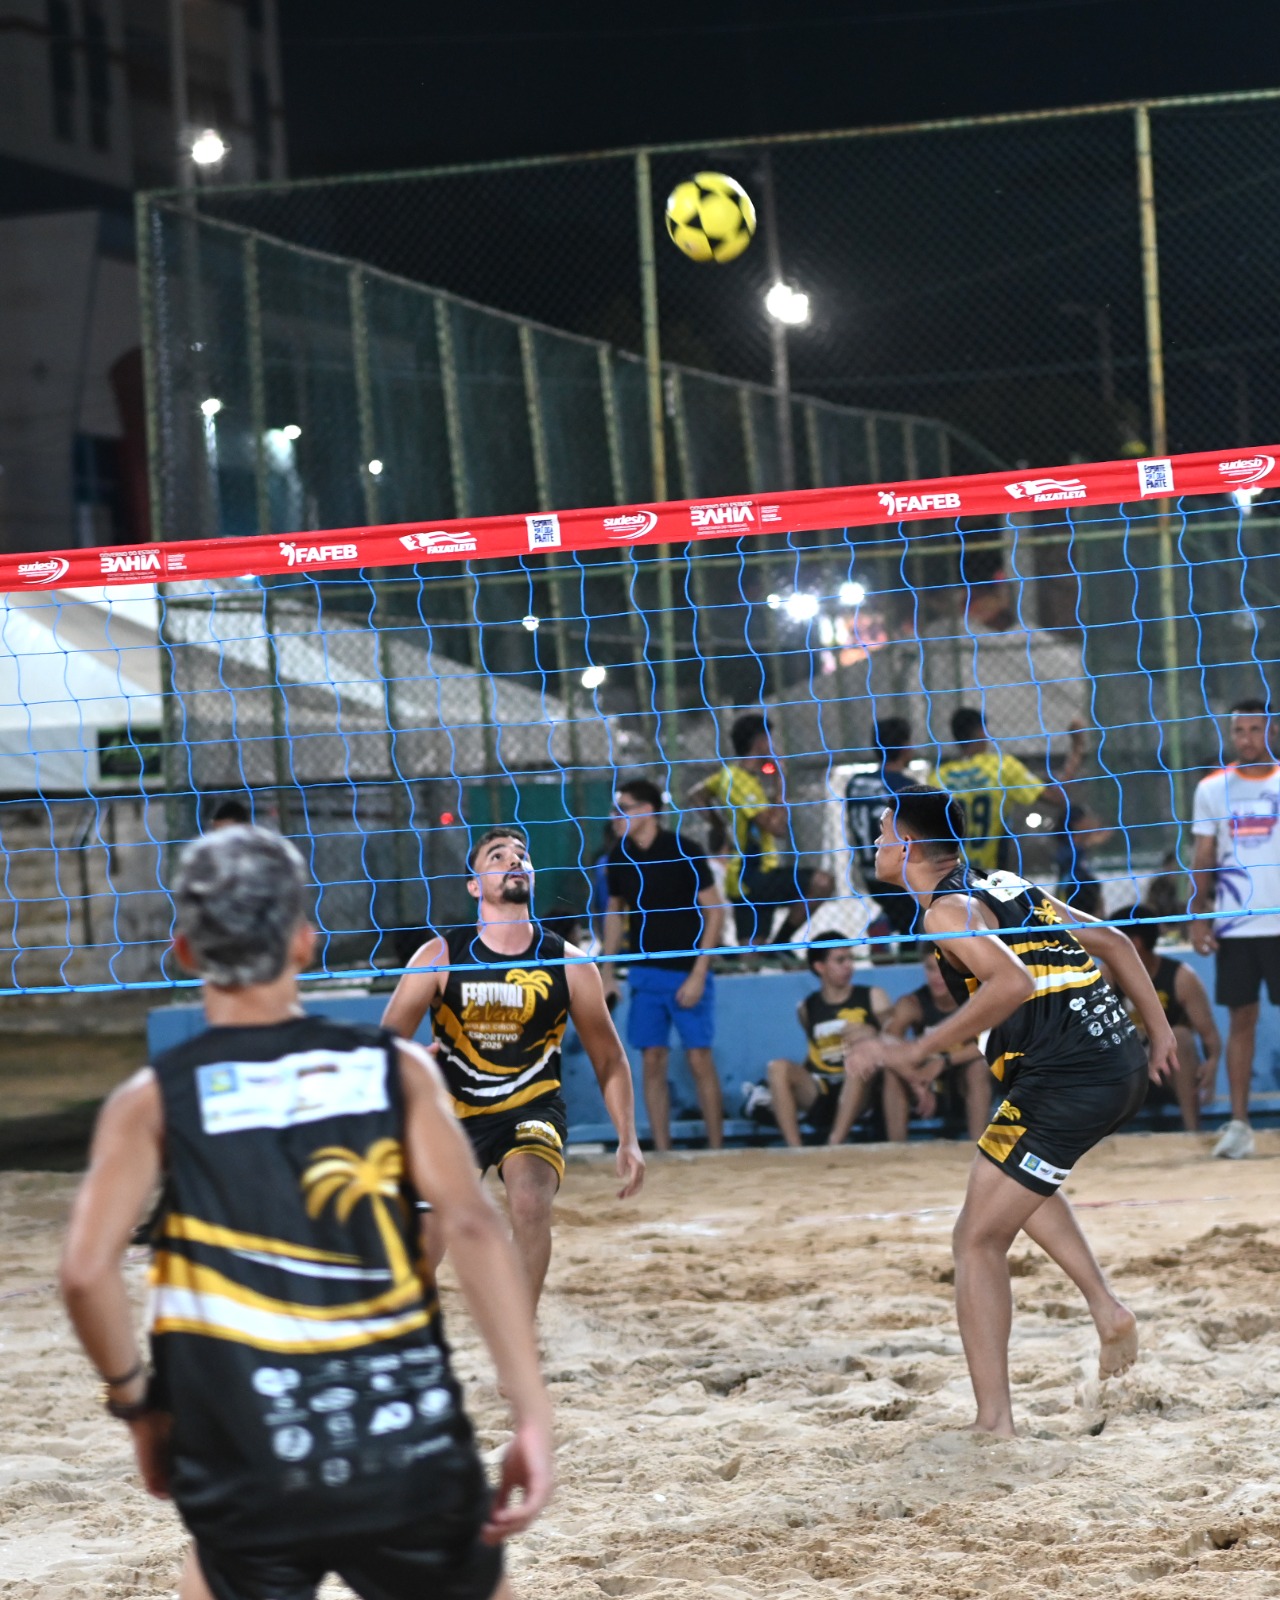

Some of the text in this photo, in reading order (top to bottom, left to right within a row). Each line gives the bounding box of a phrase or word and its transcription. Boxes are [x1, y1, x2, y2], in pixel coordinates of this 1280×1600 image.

[1218, 457, 1263, 471] sudesb
[896, 493, 961, 512] FAFEB
[1034, 490, 1086, 503] FAZATLETA
[603, 514, 646, 527] sudesb
[690, 506, 755, 526] BAHIA
[296, 544, 358, 562] FAFEB
[427, 542, 477, 554] FAZATLETA
[18, 560, 58, 573] sudesb
[100, 554, 161, 573] BAHIA
[461, 982, 523, 1008] FESTIVAL
[468, 1030, 518, 1041] ESPORTIVO
